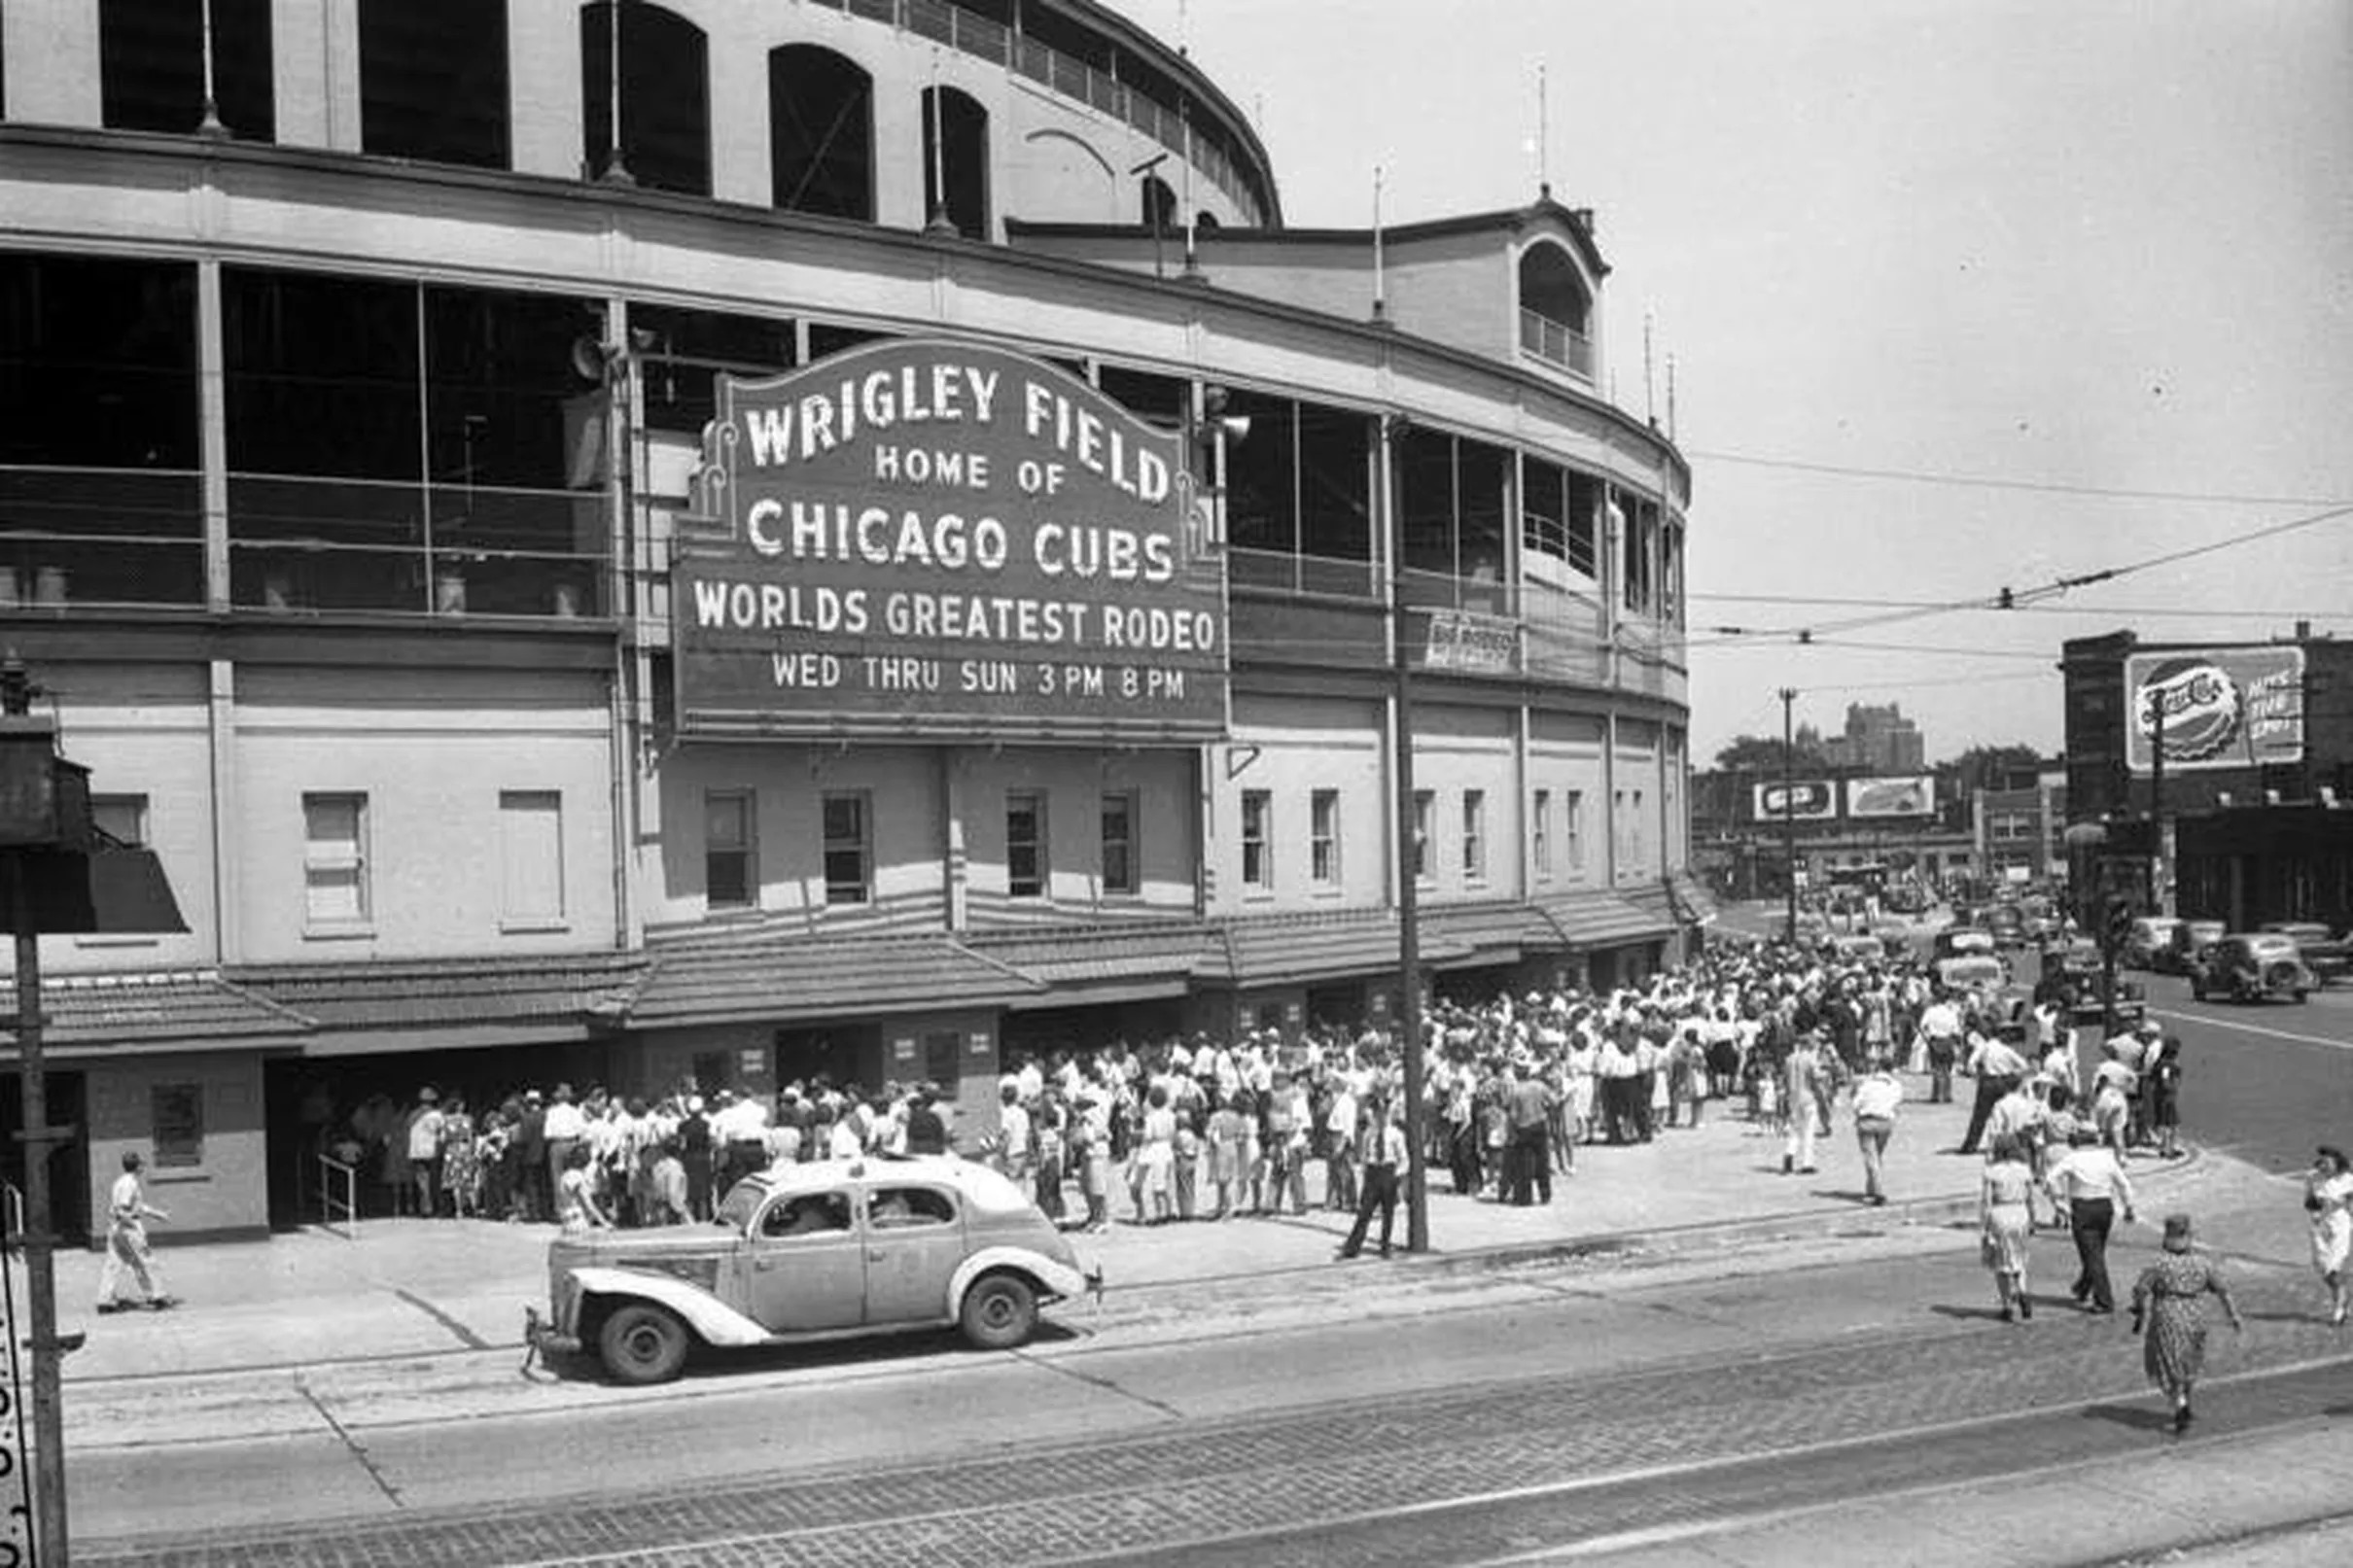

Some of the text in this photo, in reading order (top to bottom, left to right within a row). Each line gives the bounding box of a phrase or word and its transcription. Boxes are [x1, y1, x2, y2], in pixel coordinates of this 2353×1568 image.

[746, 365, 1169, 502] WRIGLEY FIELD
[876, 444, 1065, 495] HOME OF
[748, 499, 1173, 581] CHICAGO CUBS
[694, 580, 1214, 650] WORLDS GREATEST RODEO
[772, 653, 840, 687] WED
[863, 657, 939, 691] THRU
[961, 661, 1016, 693] SUN
